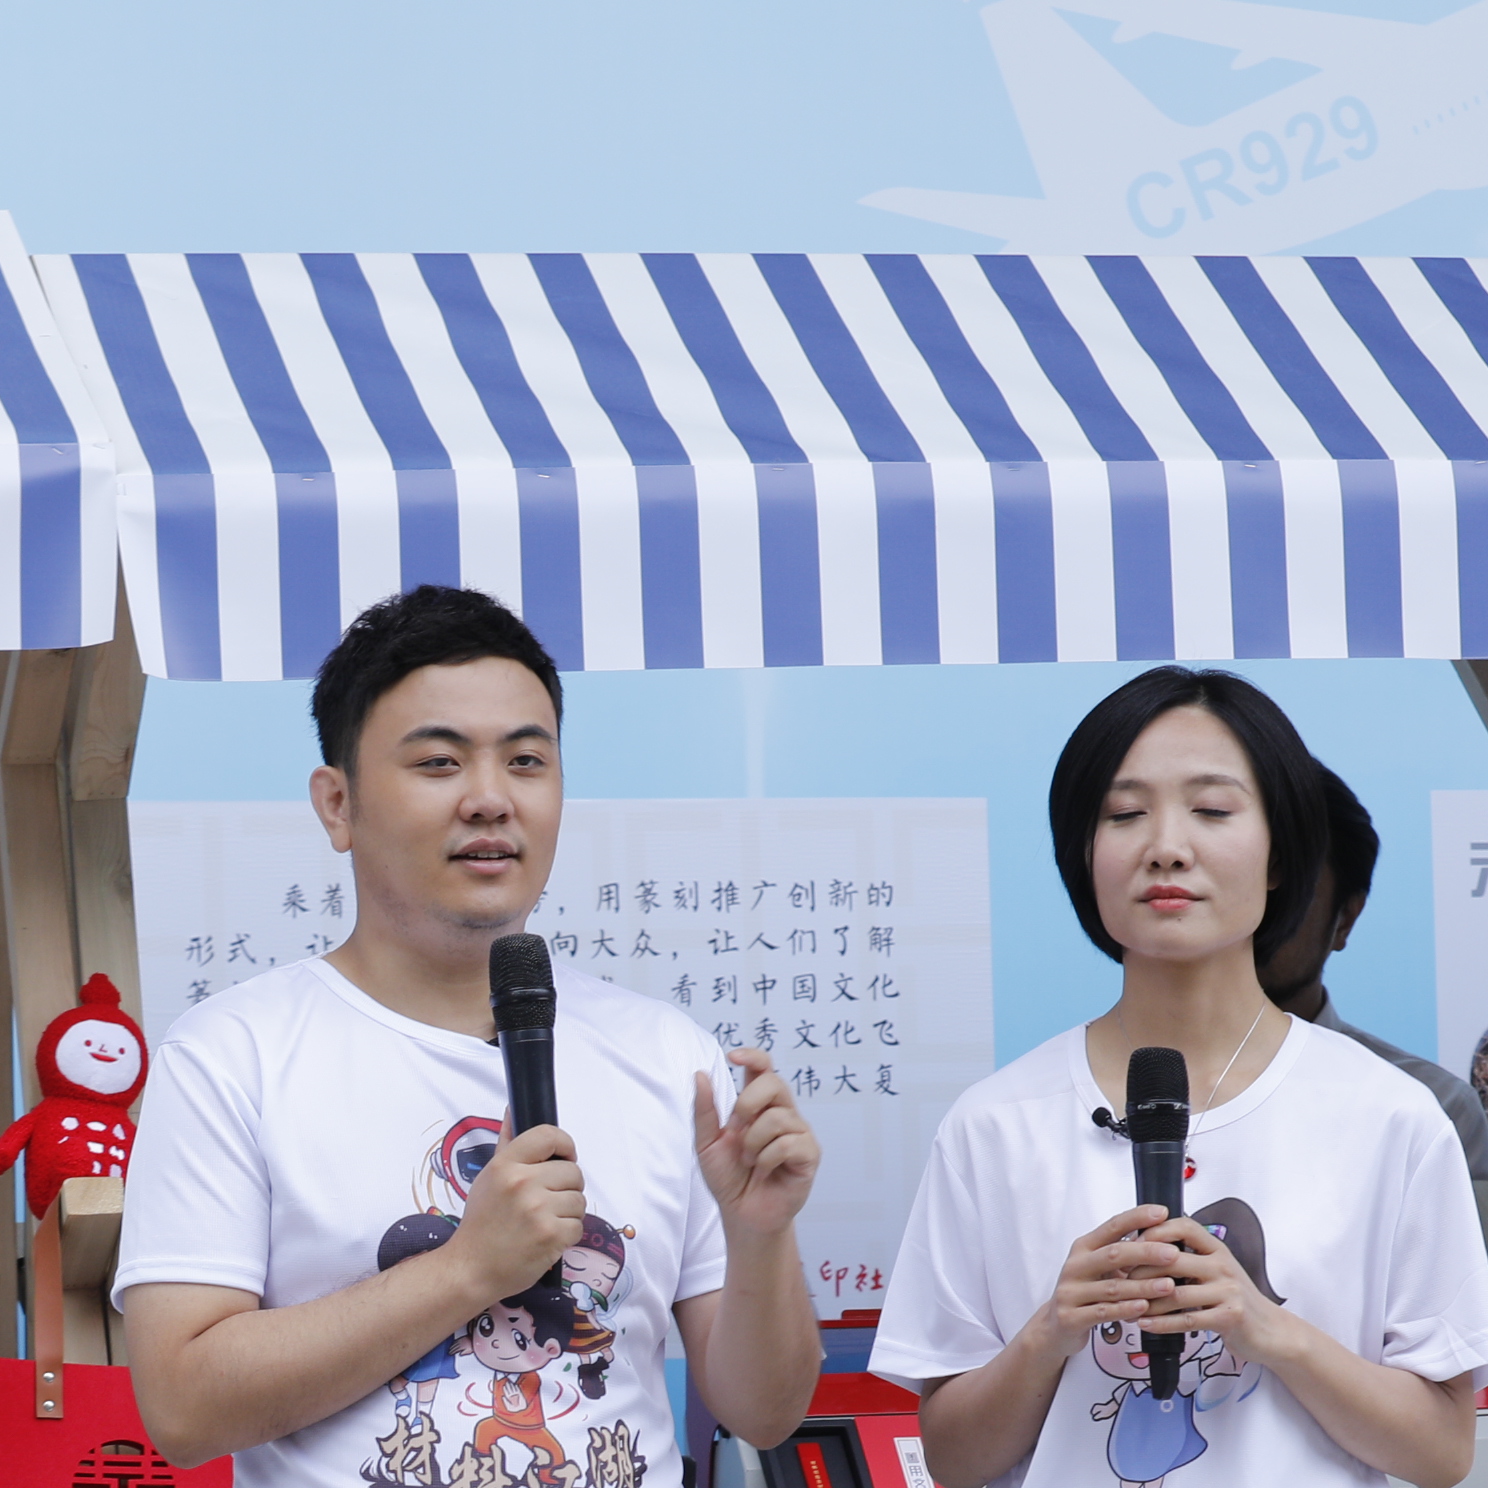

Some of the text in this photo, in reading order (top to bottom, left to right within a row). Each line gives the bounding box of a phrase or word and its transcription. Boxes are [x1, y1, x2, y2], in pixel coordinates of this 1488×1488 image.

[1123, 93, 1381, 239] CR929
[281, 883, 346, 919] 乘着
[549, 925, 896, 961] 向大众，让人们了解
[670, 973, 902, 1006] 看到中国文化
[711, 1017, 902, 1052] 优秀文化飞
